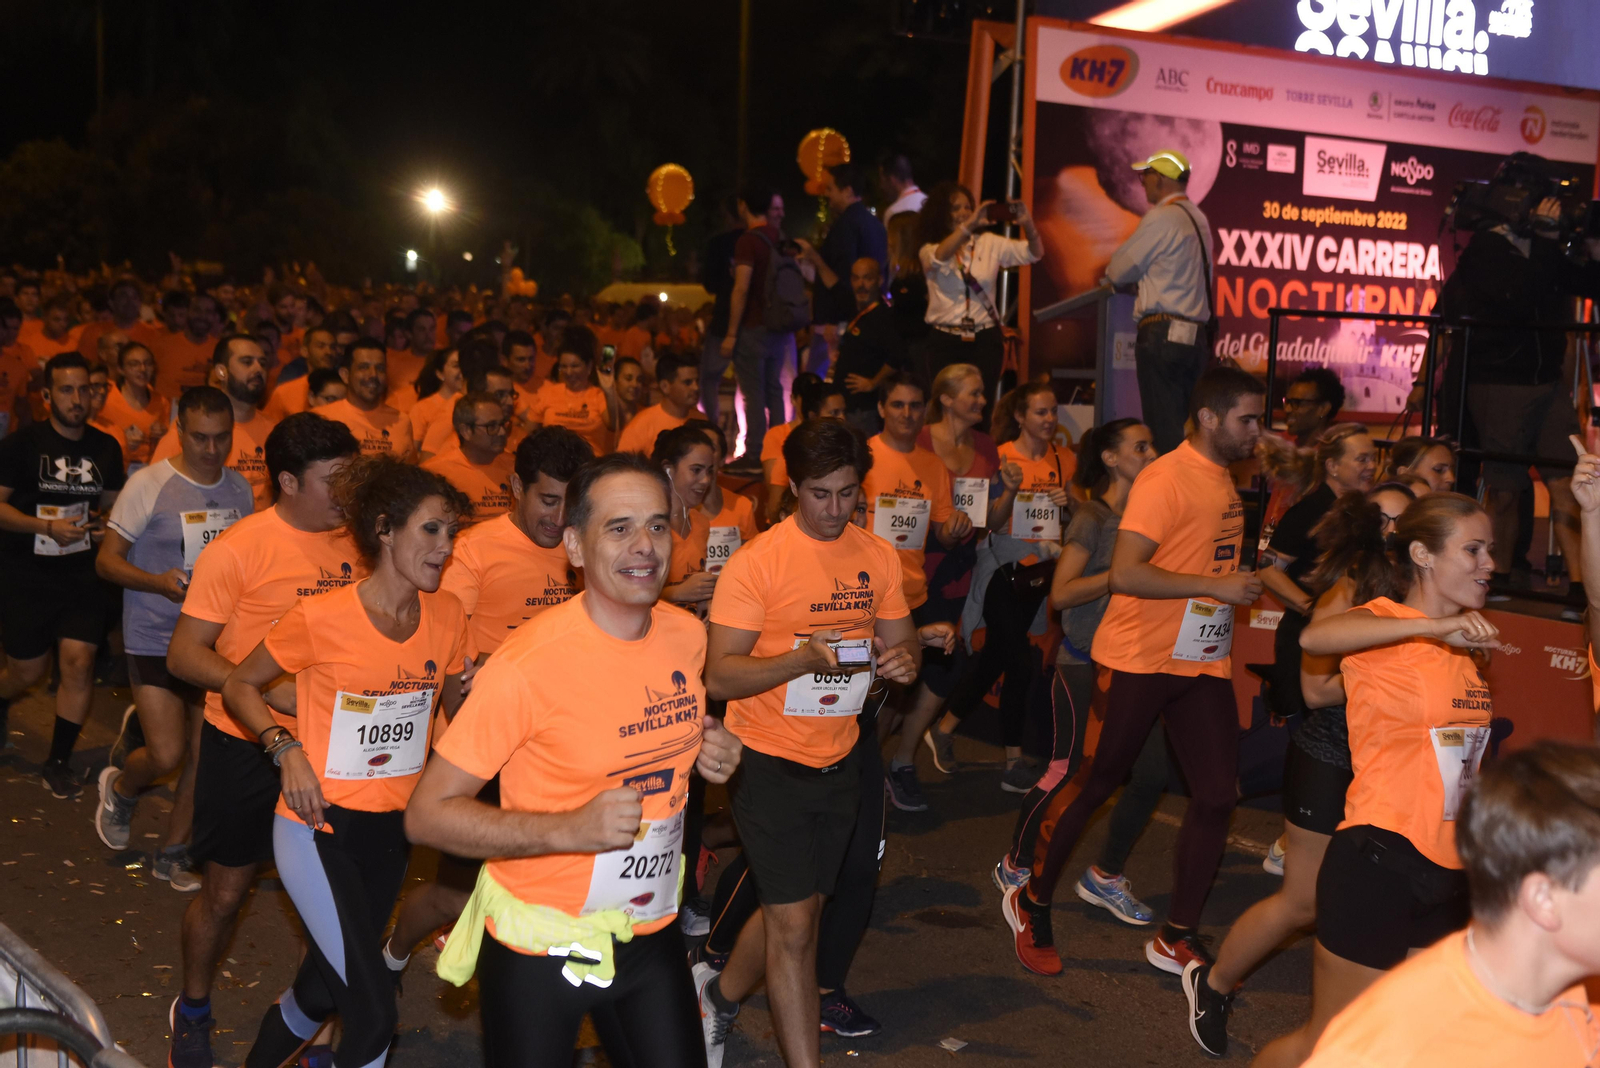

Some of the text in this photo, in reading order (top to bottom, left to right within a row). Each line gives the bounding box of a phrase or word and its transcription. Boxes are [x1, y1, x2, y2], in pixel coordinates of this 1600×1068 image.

[1155, 68, 1190, 87] ABC
[1206, 77, 1274, 101] Cruzcampo
[1286, 90, 1353, 109] TORRE SEVILLA
[1243, 142, 1260, 155] IMD
[1263, 200, 1408, 230] 30 de septiembre 2022
[1217, 228, 1440, 281] XXXIV CARRERA
[1216, 276, 1438, 328] NOCTURNA
[1215, 333, 1244, 357] del
[891, 515, 917, 529] 2940
[1025, 508, 1055, 521] 14881
[525, 596, 561, 606] SEVILLA
[830, 590, 874, 601] NOCTURNA
[810, 600, 852, 613] SEVILLA
[1199, 616, 1230, 638] 17434
[1543, 646, 1577, 657] NOCTURNA
[389, 681, 439, 691] NOCTURNA
[643, 694, 698, 717] NOCTURNA
[1452, 698, 1480, 710] SEVILLA
[357, 721, 414, 746] 10899
[618, 715, 674, 738] SEVILLA
[619, 850, 674, 879] 20272
